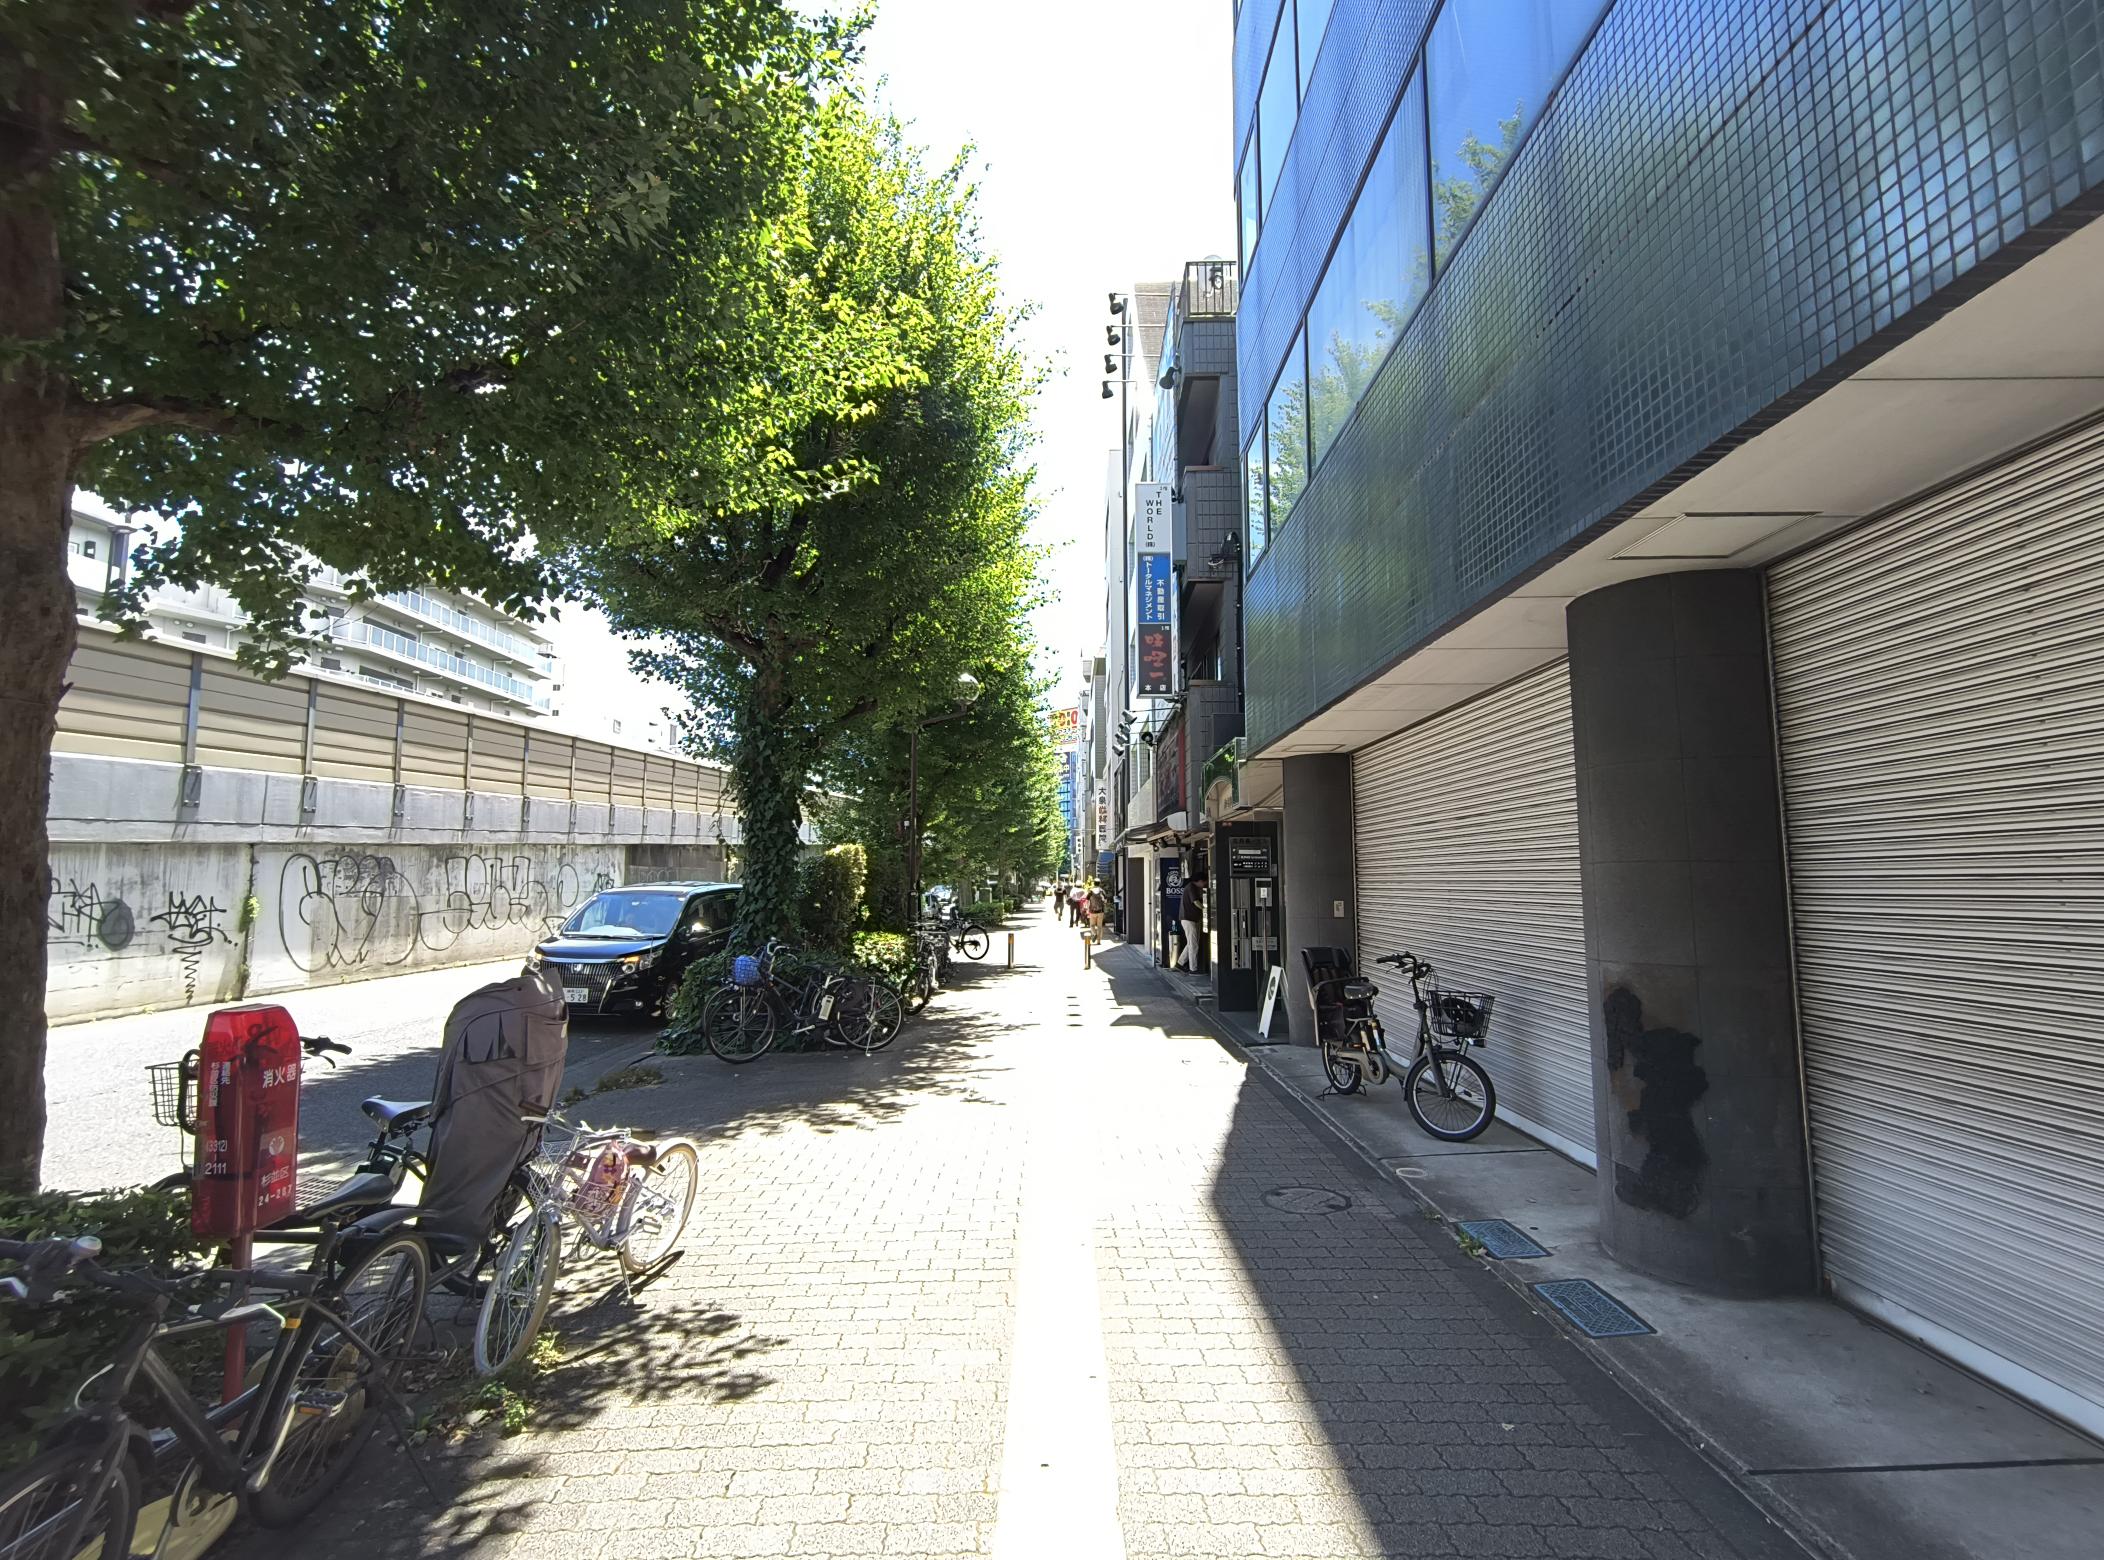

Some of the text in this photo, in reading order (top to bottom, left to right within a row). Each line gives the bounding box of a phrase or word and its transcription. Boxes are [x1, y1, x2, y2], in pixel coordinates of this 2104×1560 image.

[1165, 887, 1185, 895] BOSS
[262, 1062, 297, 1089] 消火器
[260, 1165, 290, 1188] 杉並区
